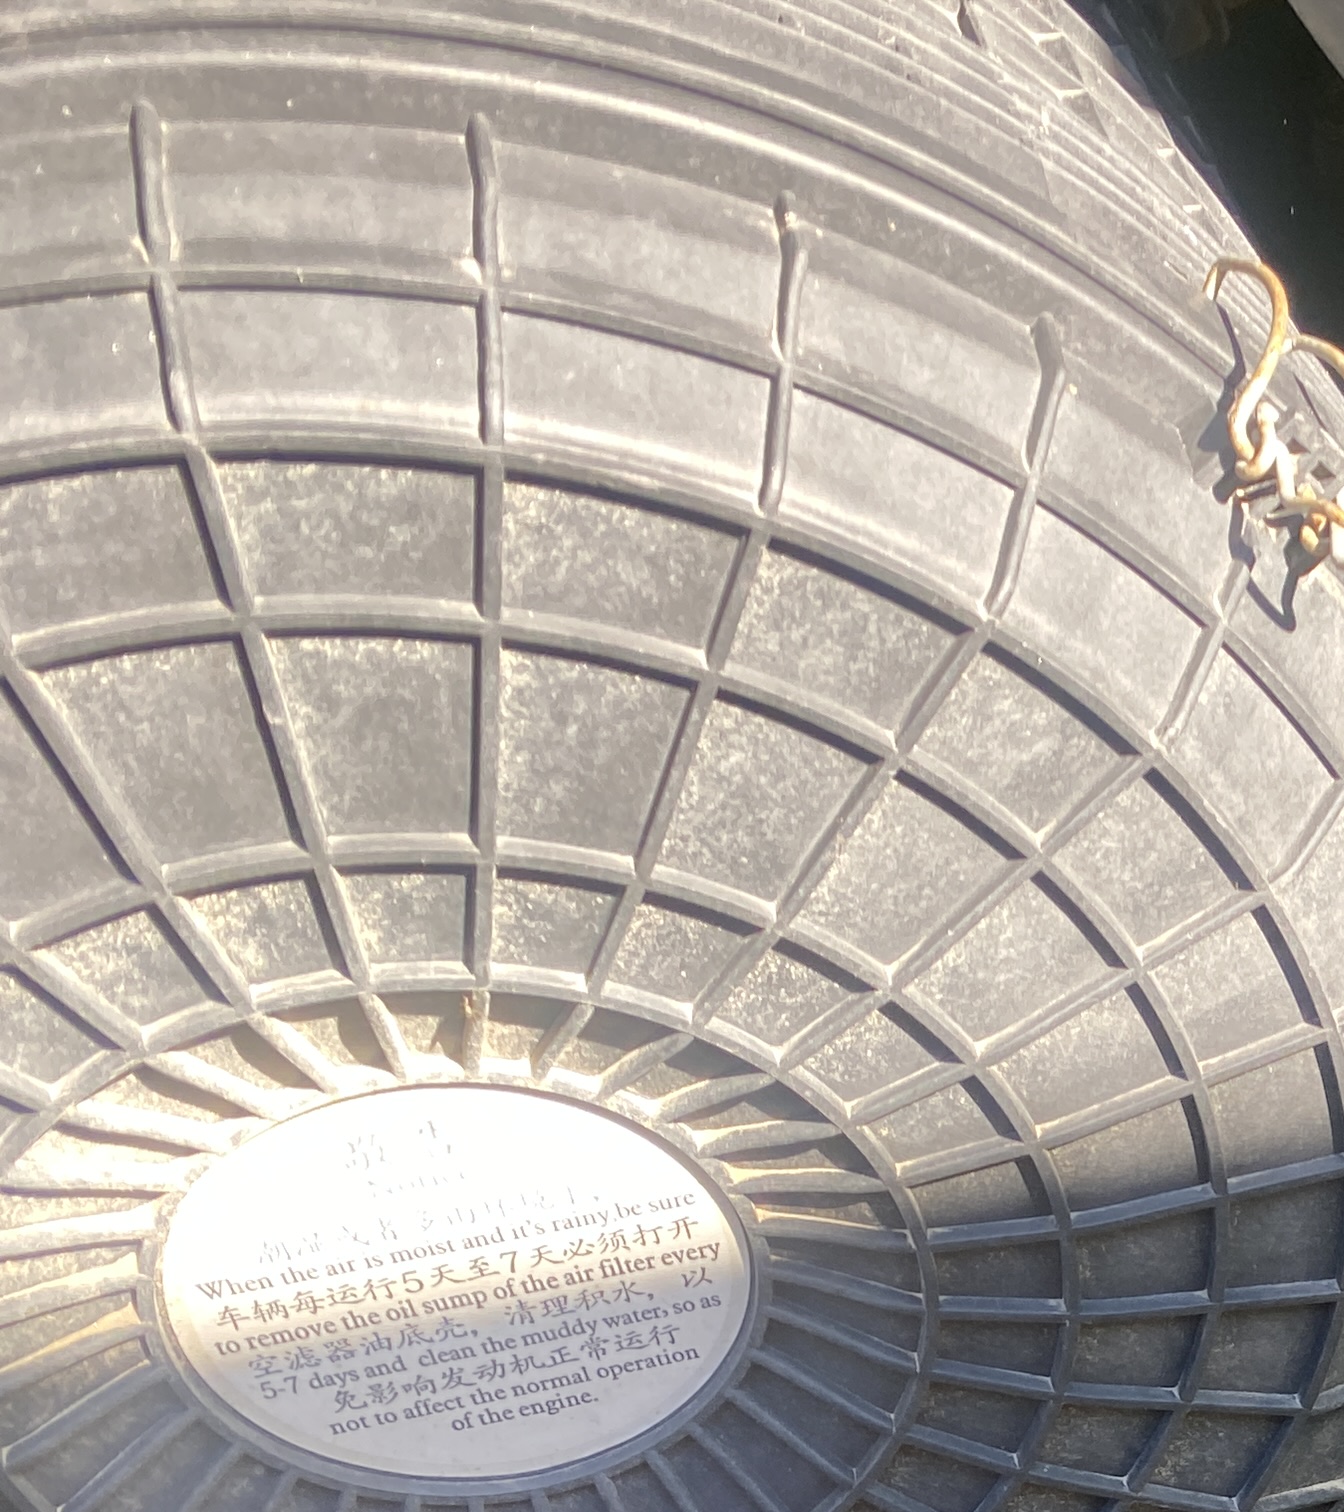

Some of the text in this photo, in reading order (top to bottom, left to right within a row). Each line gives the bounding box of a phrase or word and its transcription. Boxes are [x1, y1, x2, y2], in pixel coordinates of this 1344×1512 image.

[195, 1274, 274, 1301] When
[281, 1267, 320, 1286] the
[326, 1260, 355, 1278] air
[364, 1256, 383, 1269] is
[390, 1240, 456, 1265] moist
[463, 1226, 505, 1250] and
[649, 1193, 696, 1213] sure
[214, 1242, 720, 1356] to remove the oil sump of the air filter every
[260, 1294, 722, 1400] 5-7 days and clean the muddy water, so as
[329, 1347, 700, 1436] not to affect the normal operation
[452, 1390, 599, 1432] of the engine.
